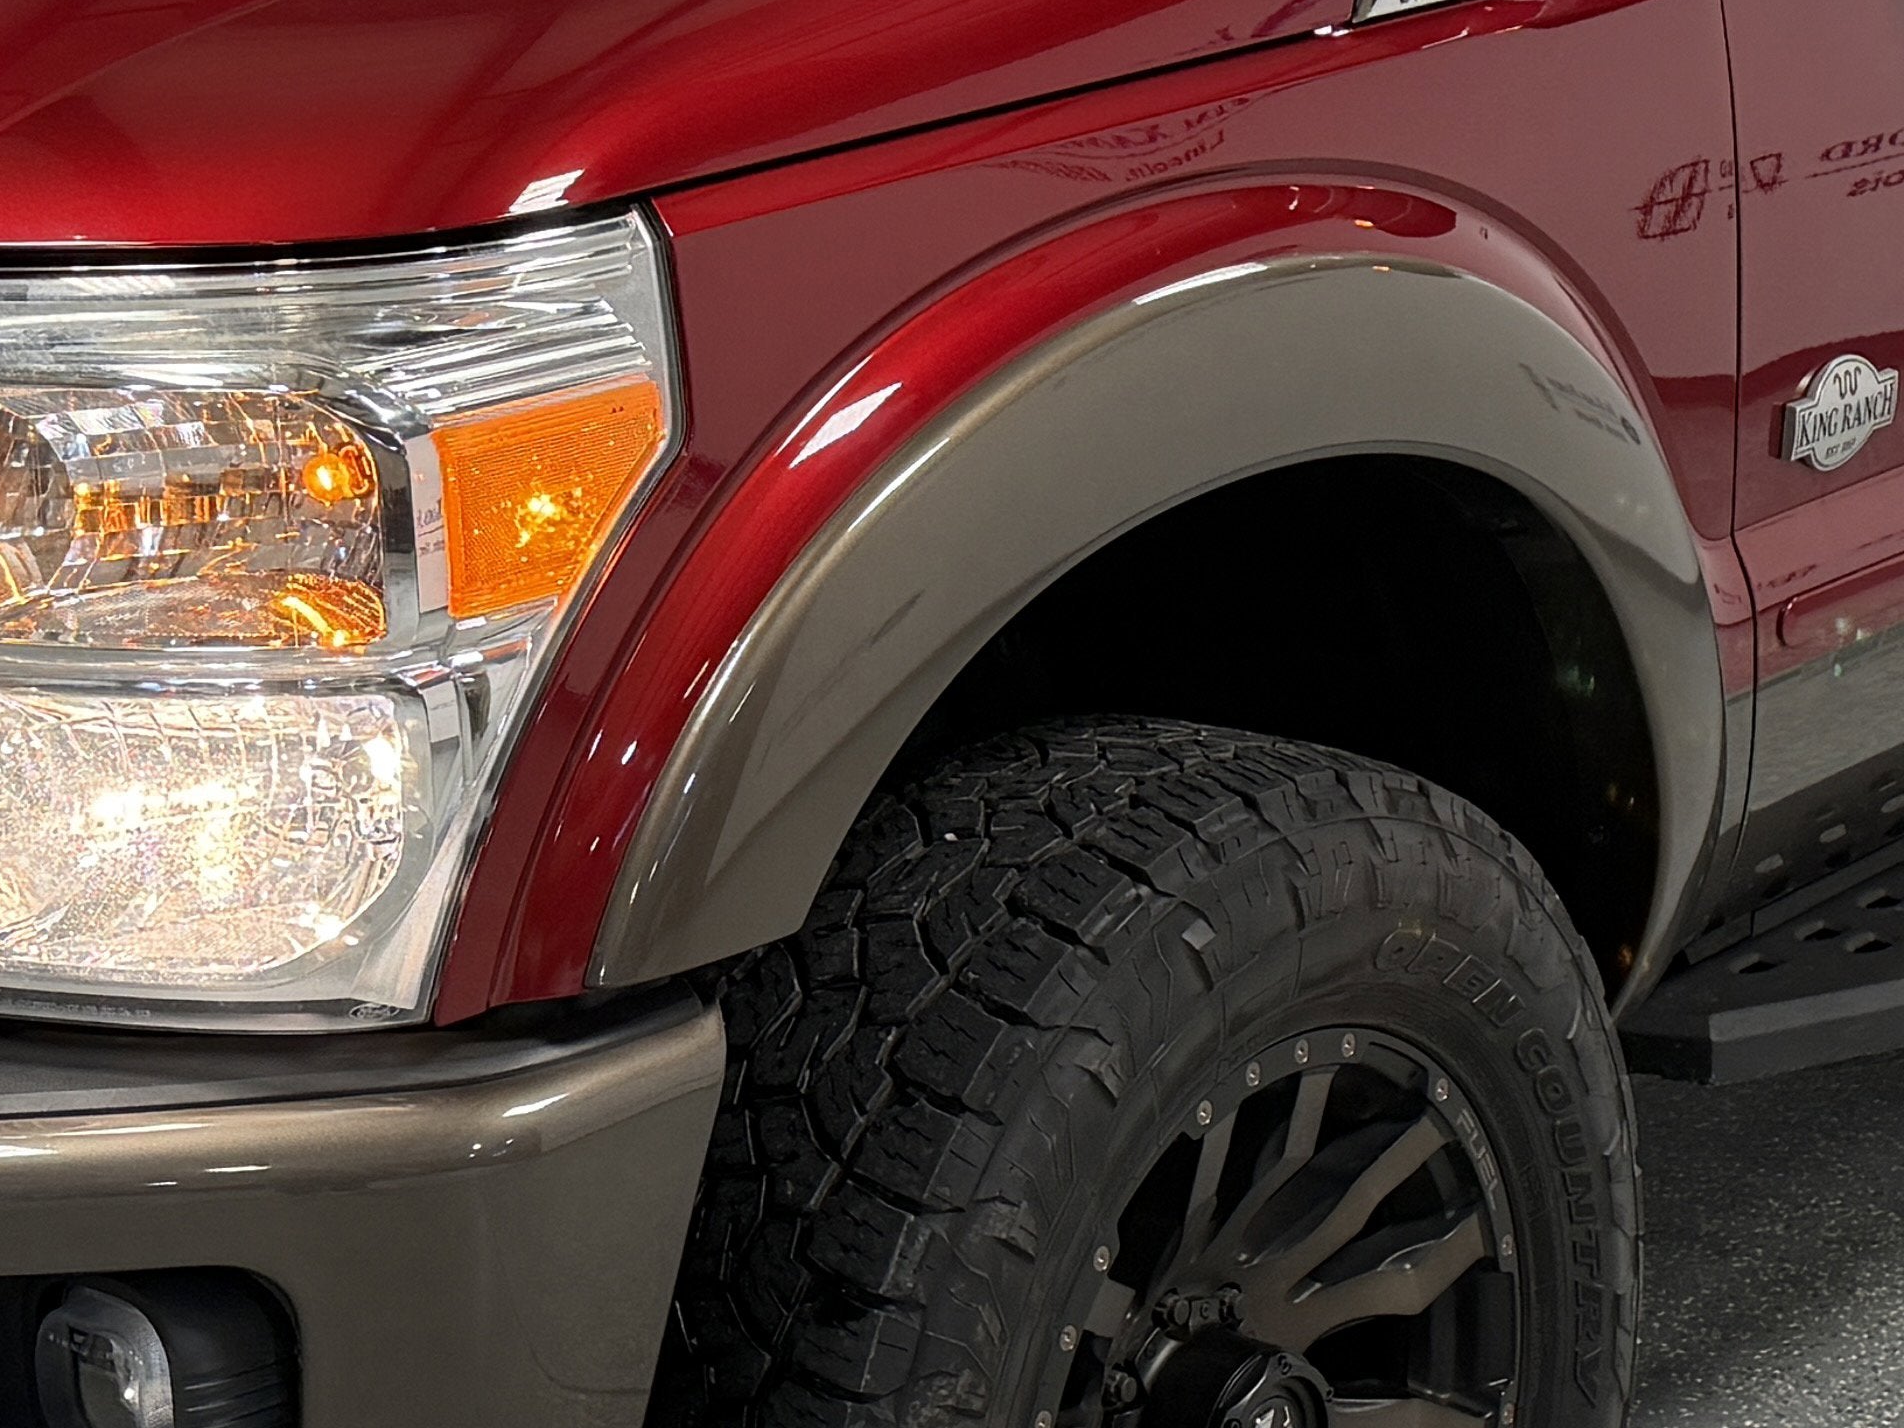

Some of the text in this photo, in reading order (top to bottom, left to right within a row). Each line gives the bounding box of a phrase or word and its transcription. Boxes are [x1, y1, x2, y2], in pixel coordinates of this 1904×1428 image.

[1799, 381, 1894, 448] KING RANCH
[1374, 928, 1527, 1029] OPEN
[1457, 1108, 1499, 1212] FUEL
